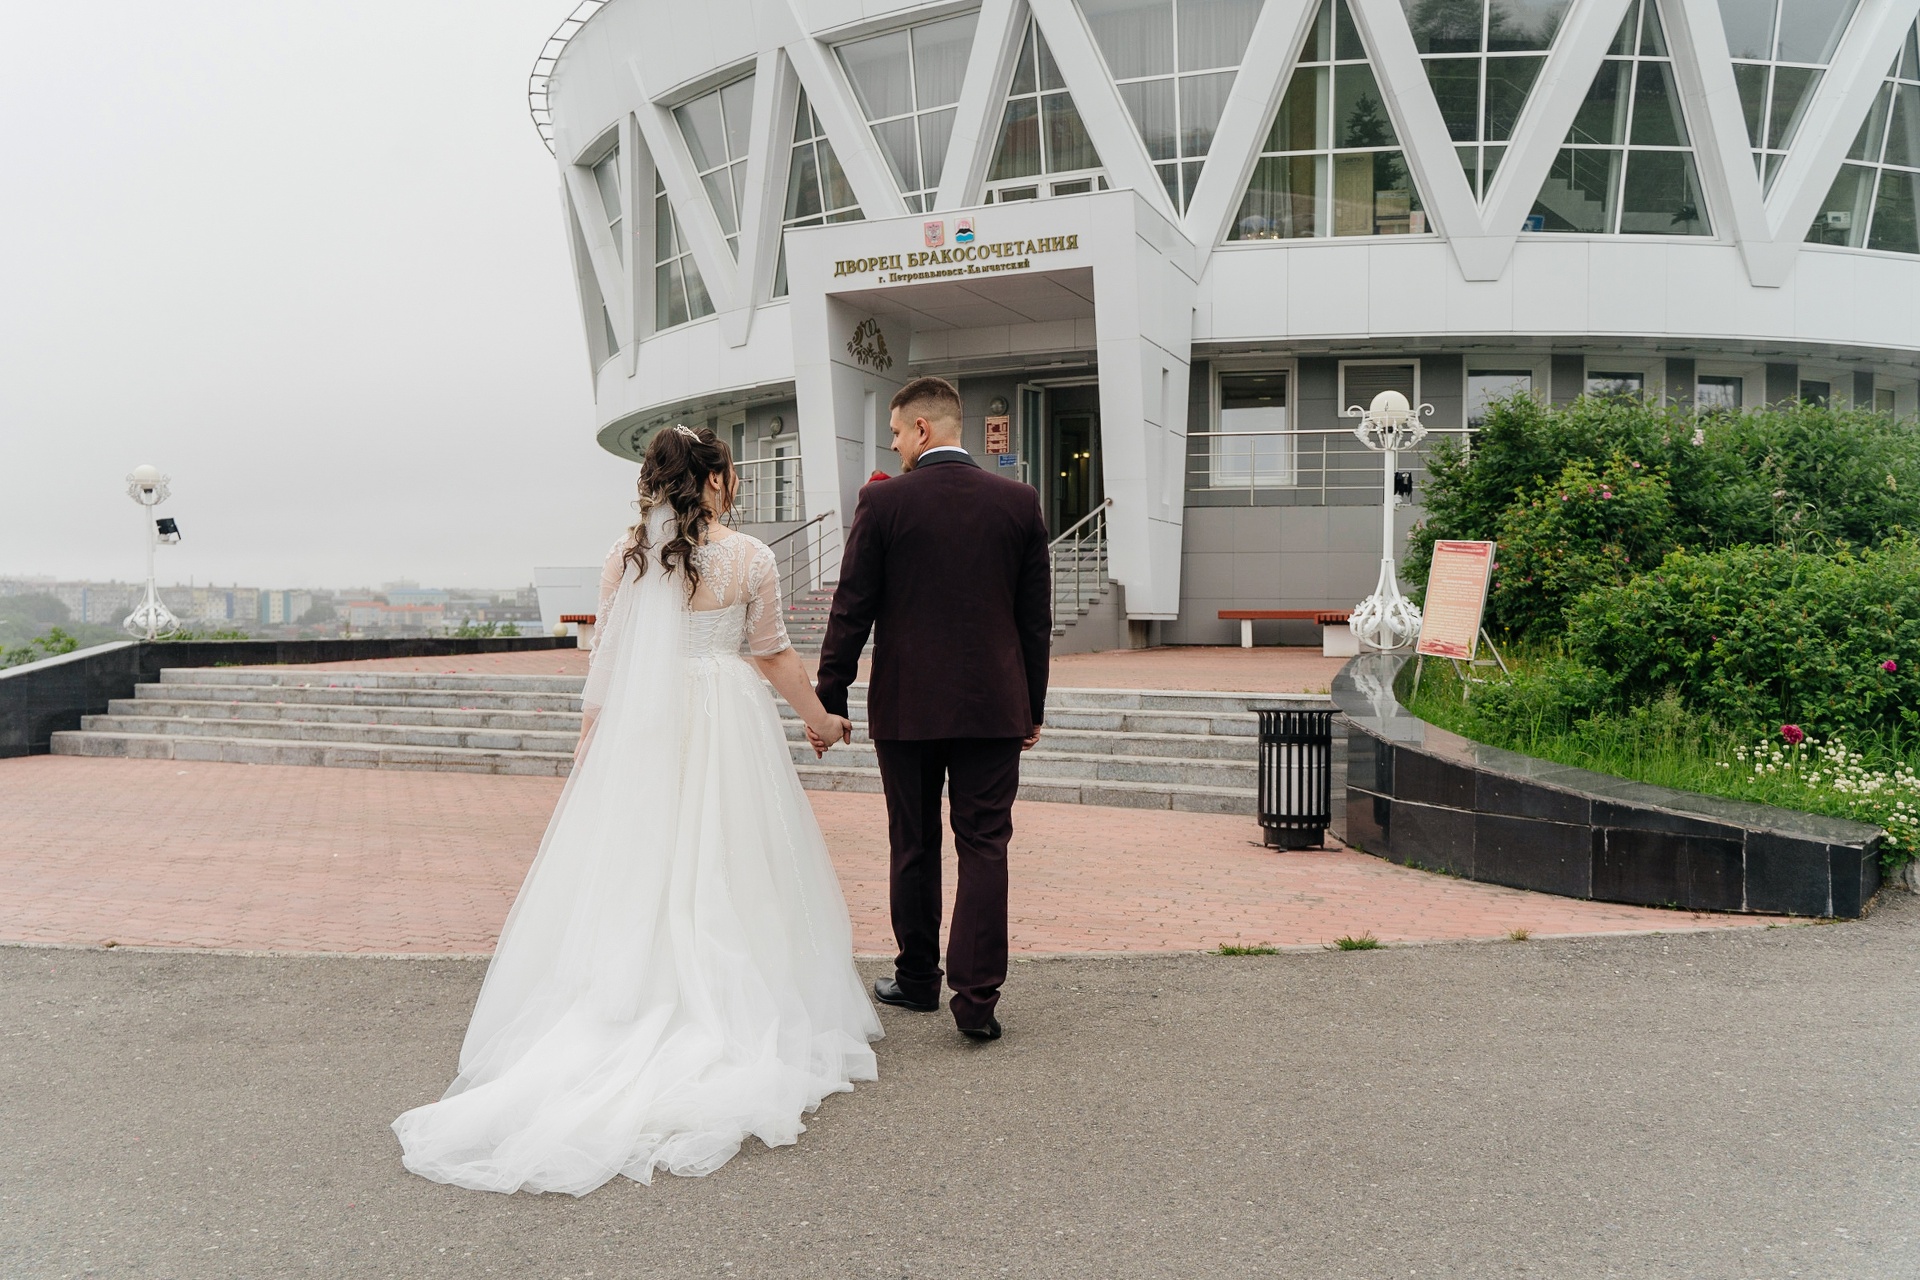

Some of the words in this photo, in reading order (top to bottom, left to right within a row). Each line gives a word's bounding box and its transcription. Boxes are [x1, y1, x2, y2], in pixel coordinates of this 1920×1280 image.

[834, 254, 903, 278] ДВОРЕЦ
[907, 234, 1079, 268] БРАКОСОЧЕТАНИЯ
[878, 276, 886, 284] г.
[889, 258, 1031, 283] Петропавловск-Камчатский
